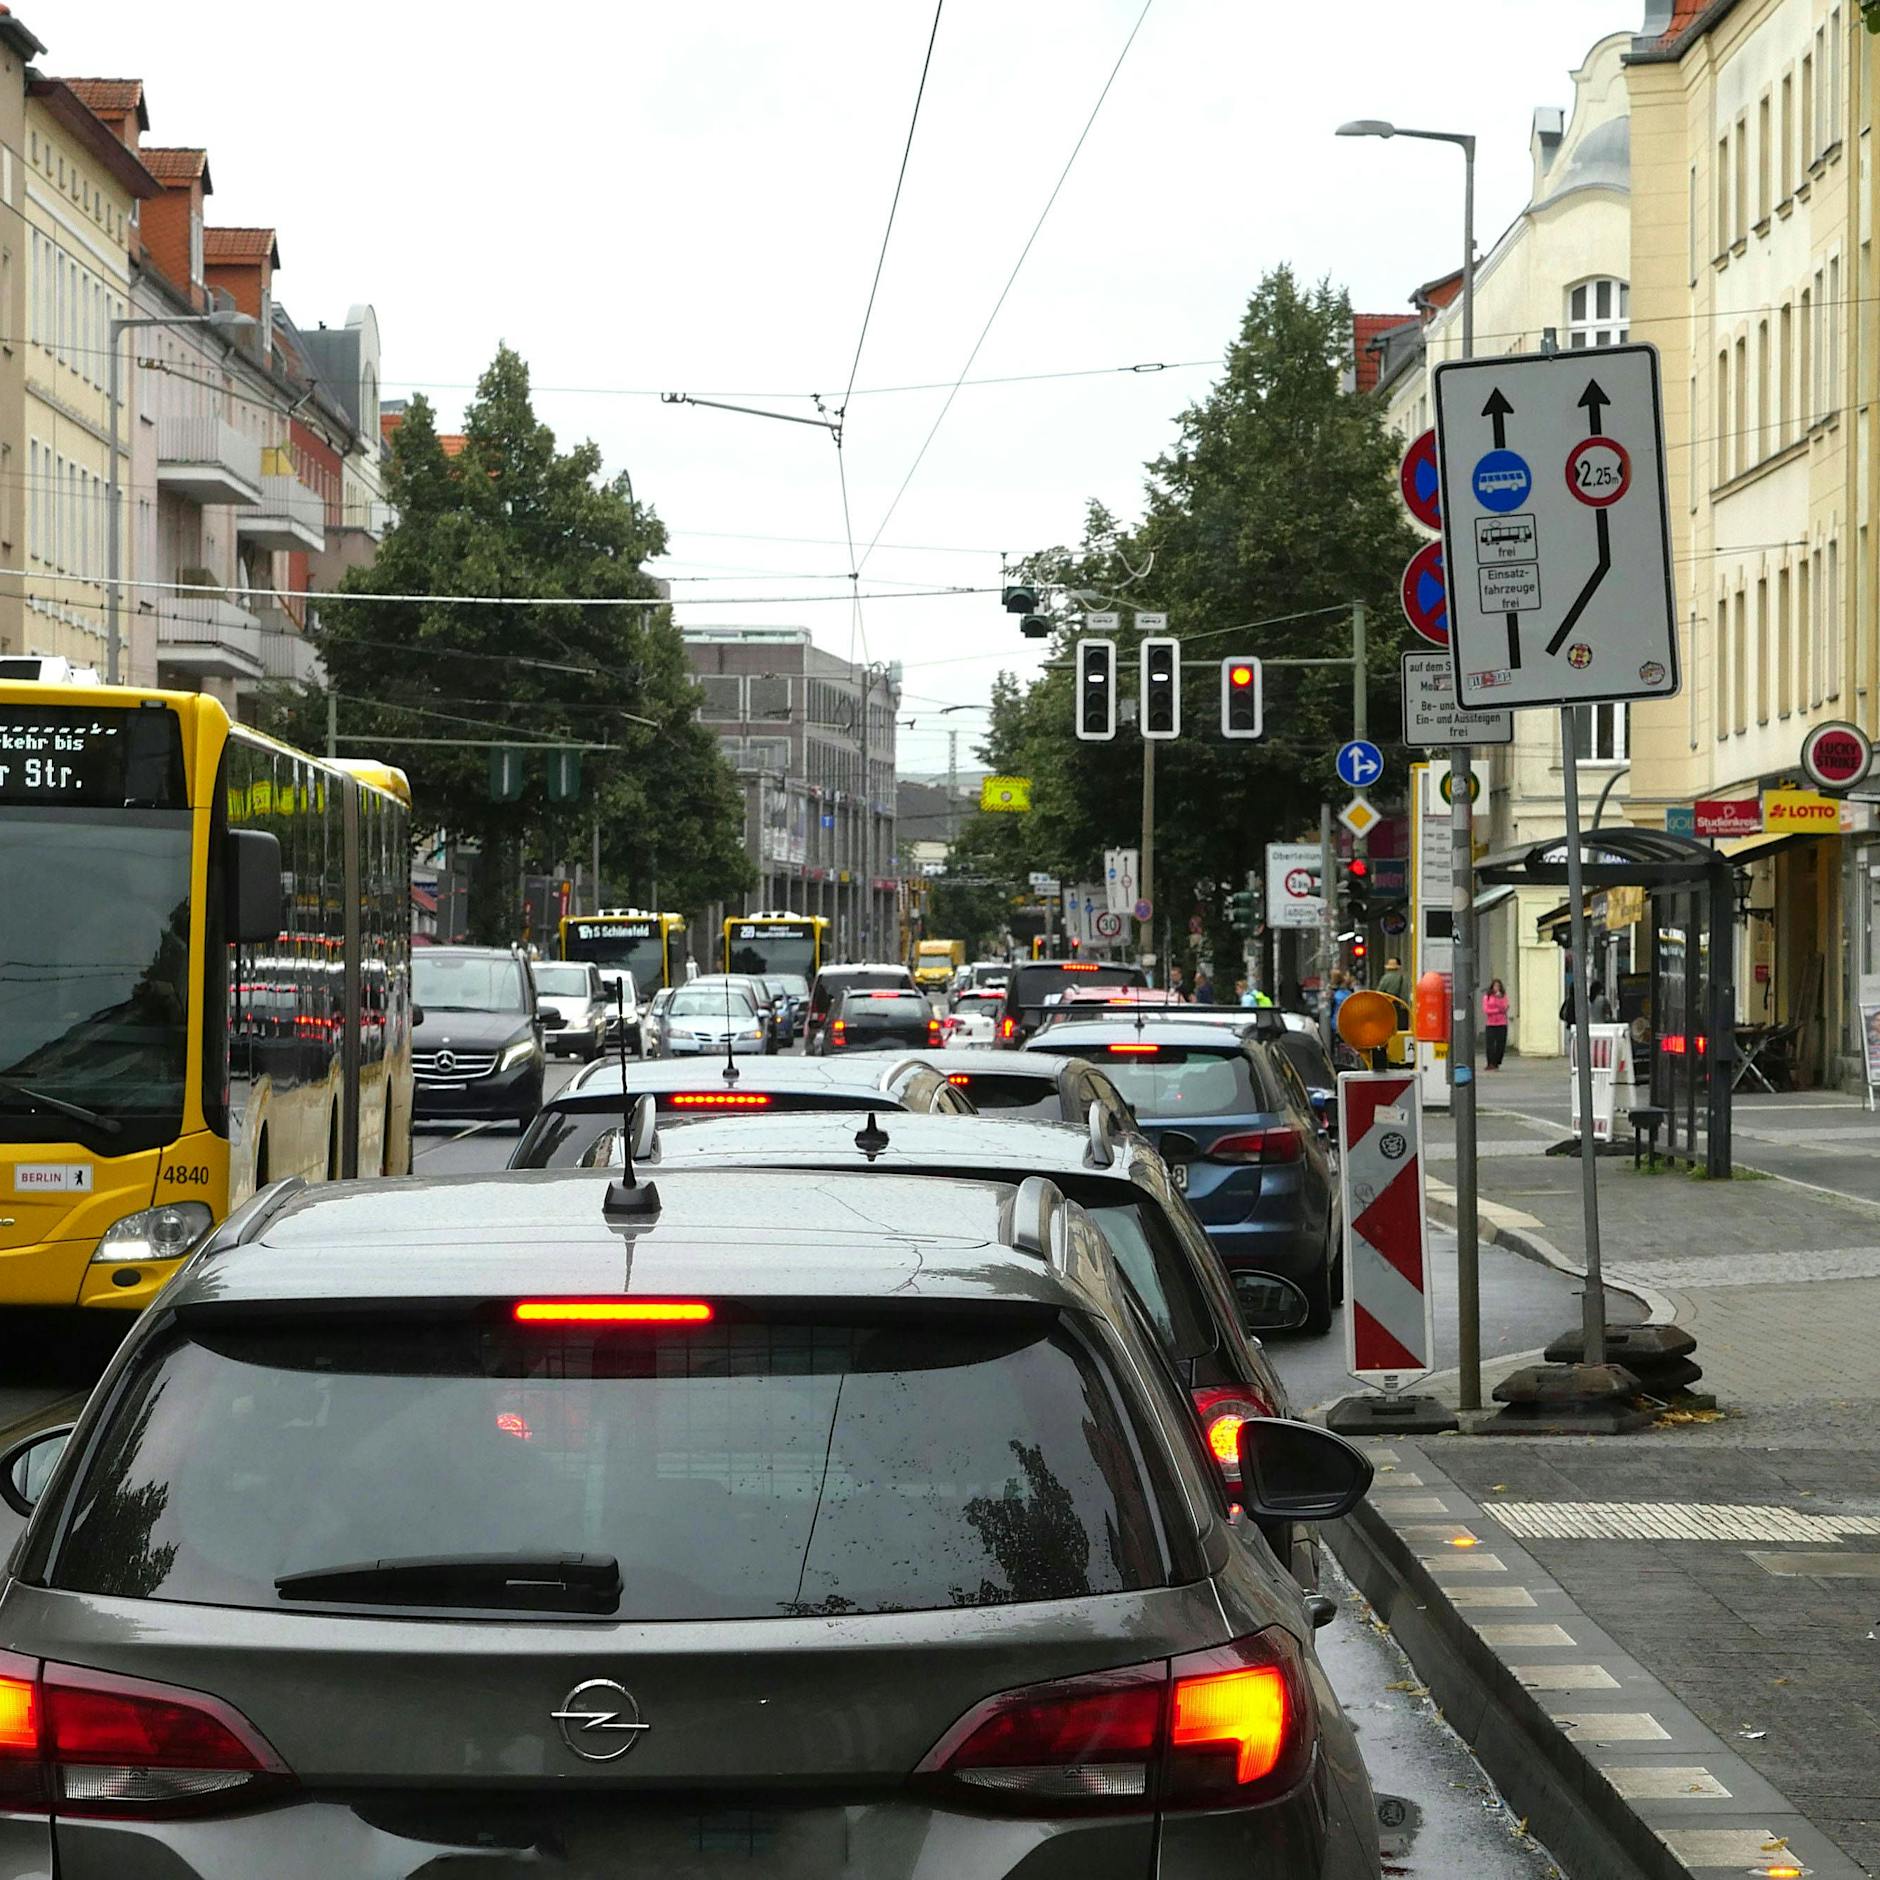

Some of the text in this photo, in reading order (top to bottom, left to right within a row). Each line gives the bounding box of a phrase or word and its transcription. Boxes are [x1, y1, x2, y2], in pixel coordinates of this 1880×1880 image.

[1498, 547, 1516, 557] frei
[1488, 569, 1530, 580] Einsatz-
[1484, 583, 1535, 595] fahrzeuge
[1502, 598, 1520, 609] frei
[1409, 661, 1451, 672] auf dem S
[1421, 701, 1437, 711] Be-
[1416, 714, 1501, 725] Ein- und Aussteigen
[1450, 727, 1468, 737] frei
[0, 734, 84, 751] kehr bis
[25, 758, 82, 789] Str.
[1789, 806, 1836, 818] LOTTO
[1103, 919, 1116, 930] 30
[21, 1172, 62, 1183] BERLIN
[163, 1165, 209, 1185] 4840
